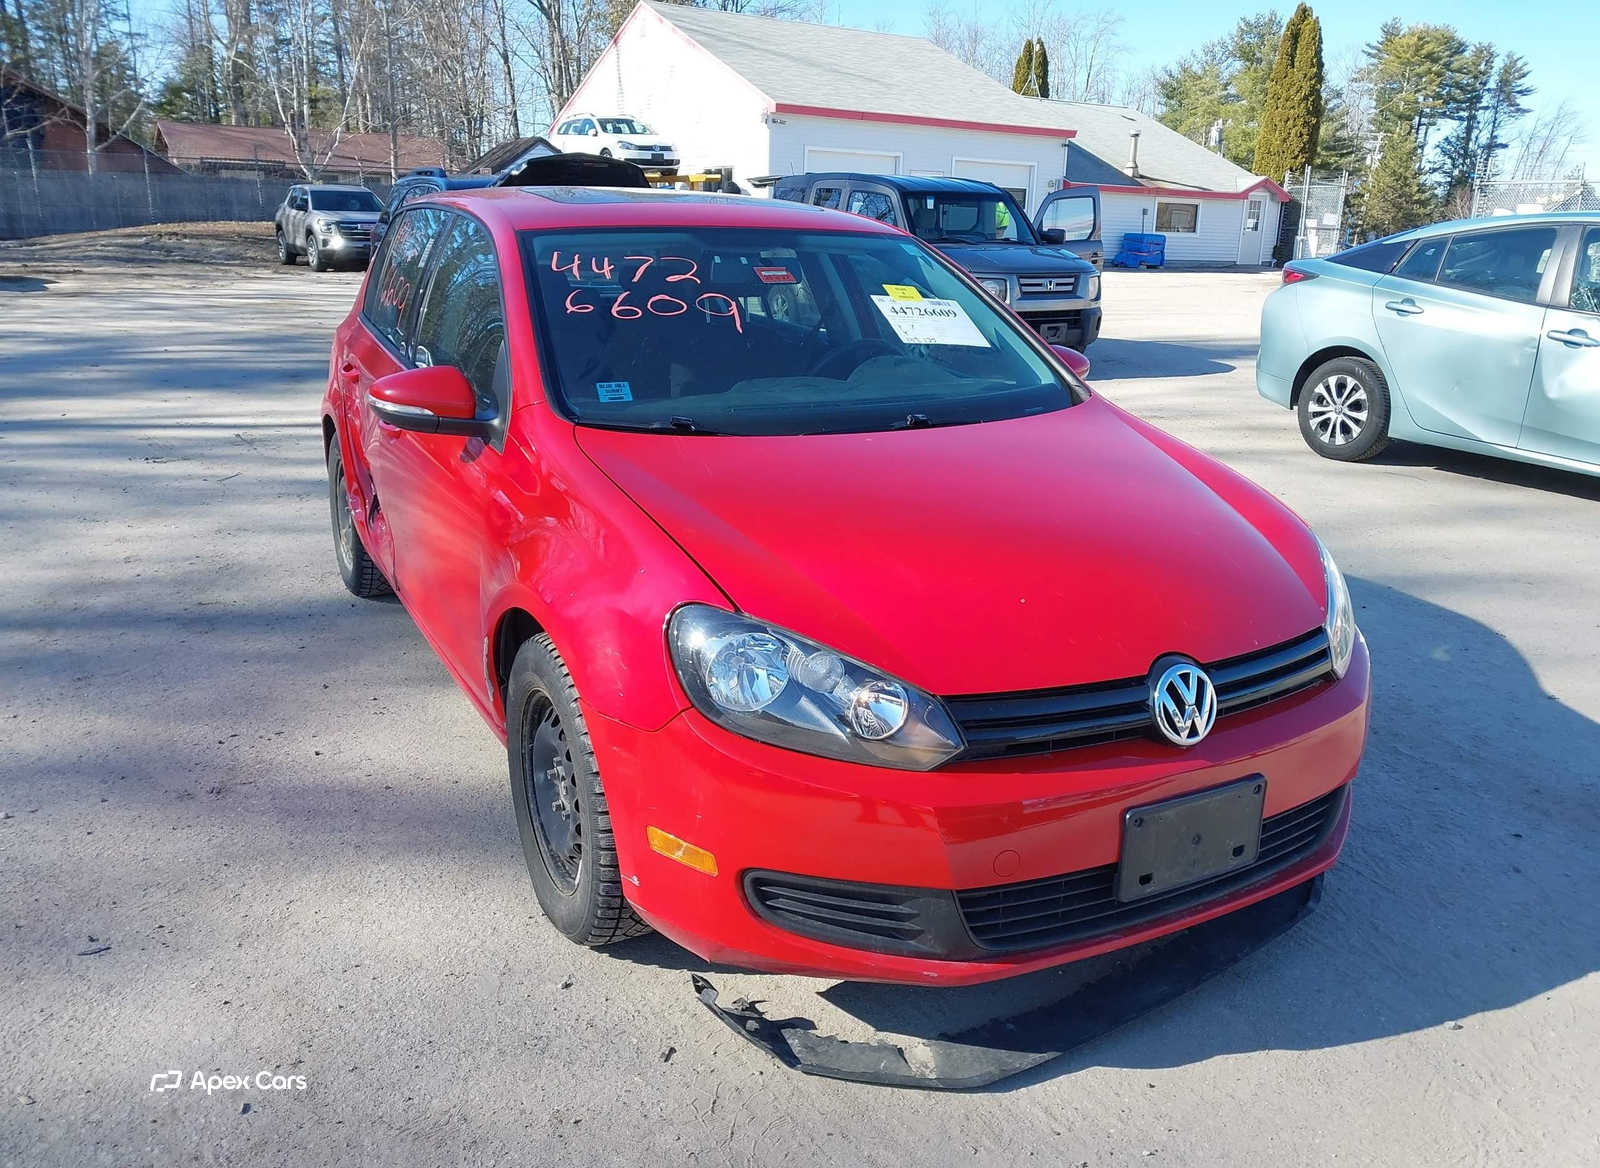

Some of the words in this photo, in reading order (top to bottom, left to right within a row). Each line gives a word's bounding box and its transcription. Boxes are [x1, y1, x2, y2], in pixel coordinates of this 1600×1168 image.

[551, 251, 701, 284] 4472
[564, 289, 743, 334] 6609
[890, 306, 958, 319] 44726609
